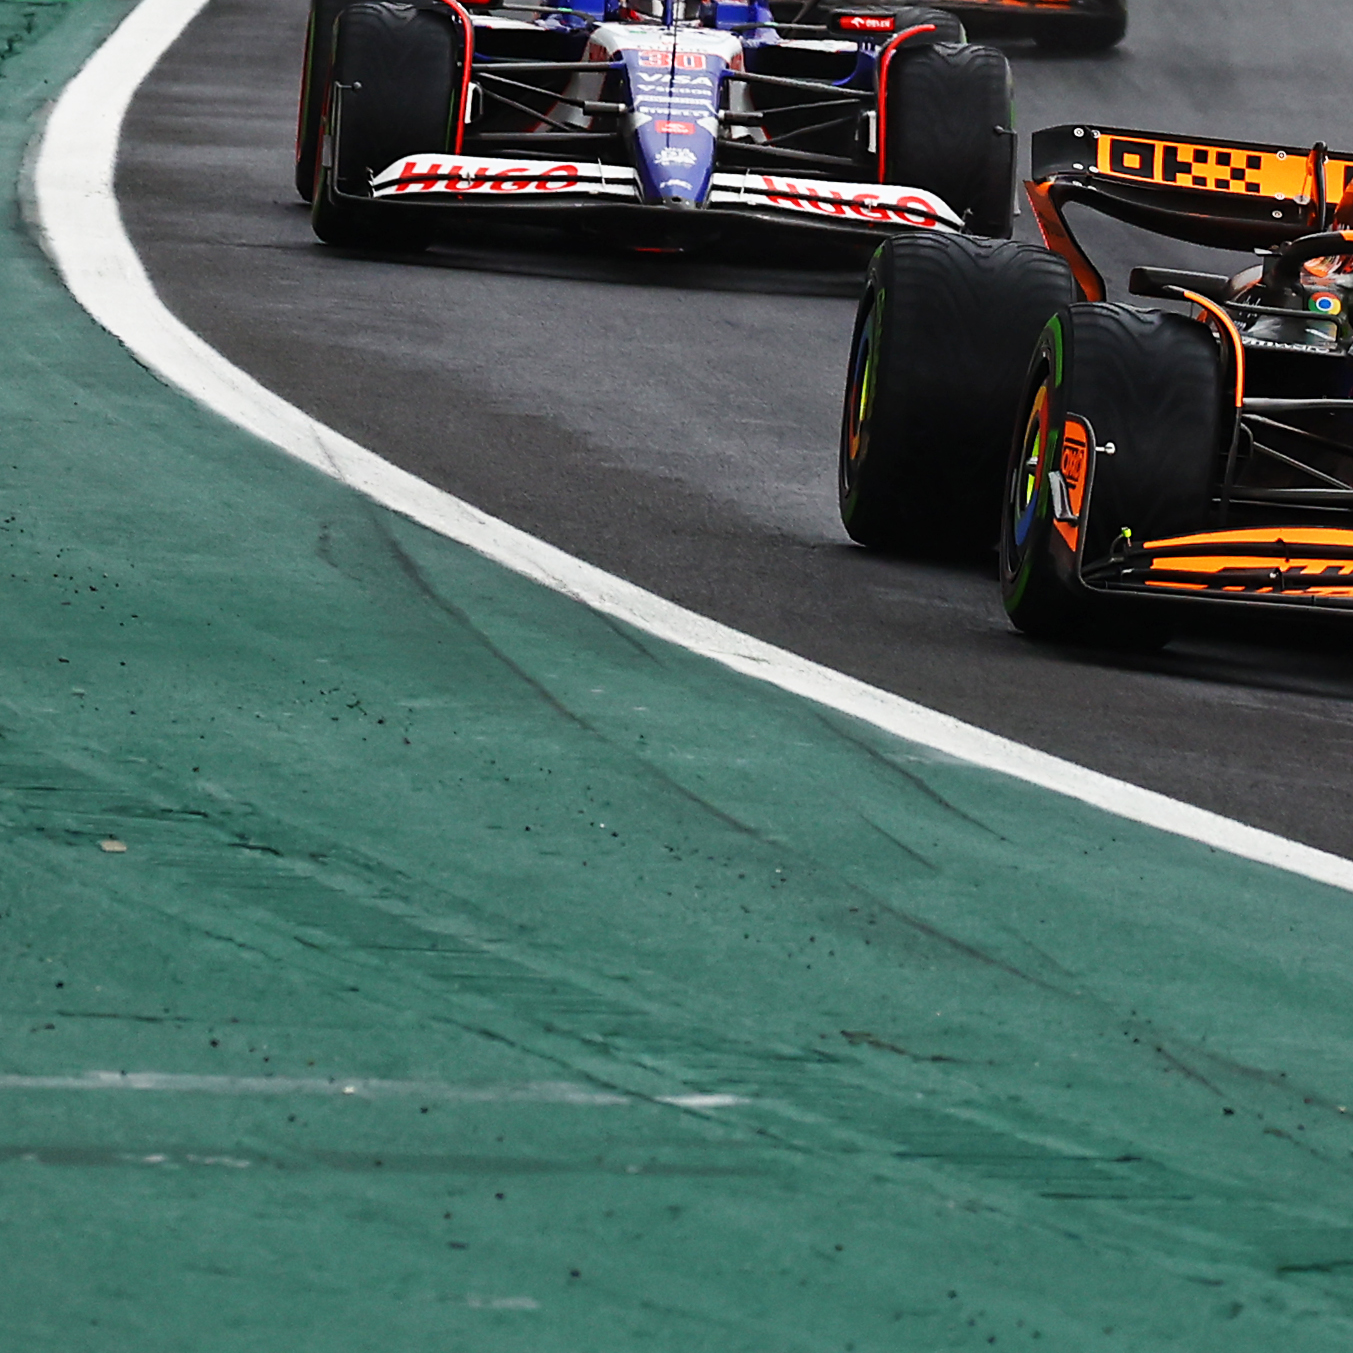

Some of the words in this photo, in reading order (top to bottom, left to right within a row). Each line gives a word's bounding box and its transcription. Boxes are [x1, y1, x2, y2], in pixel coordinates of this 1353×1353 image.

[637, 72, 714, 87] VISA
[394, 160, 579, 192] HUGO
[761, 174, 938, 227] HUGO
